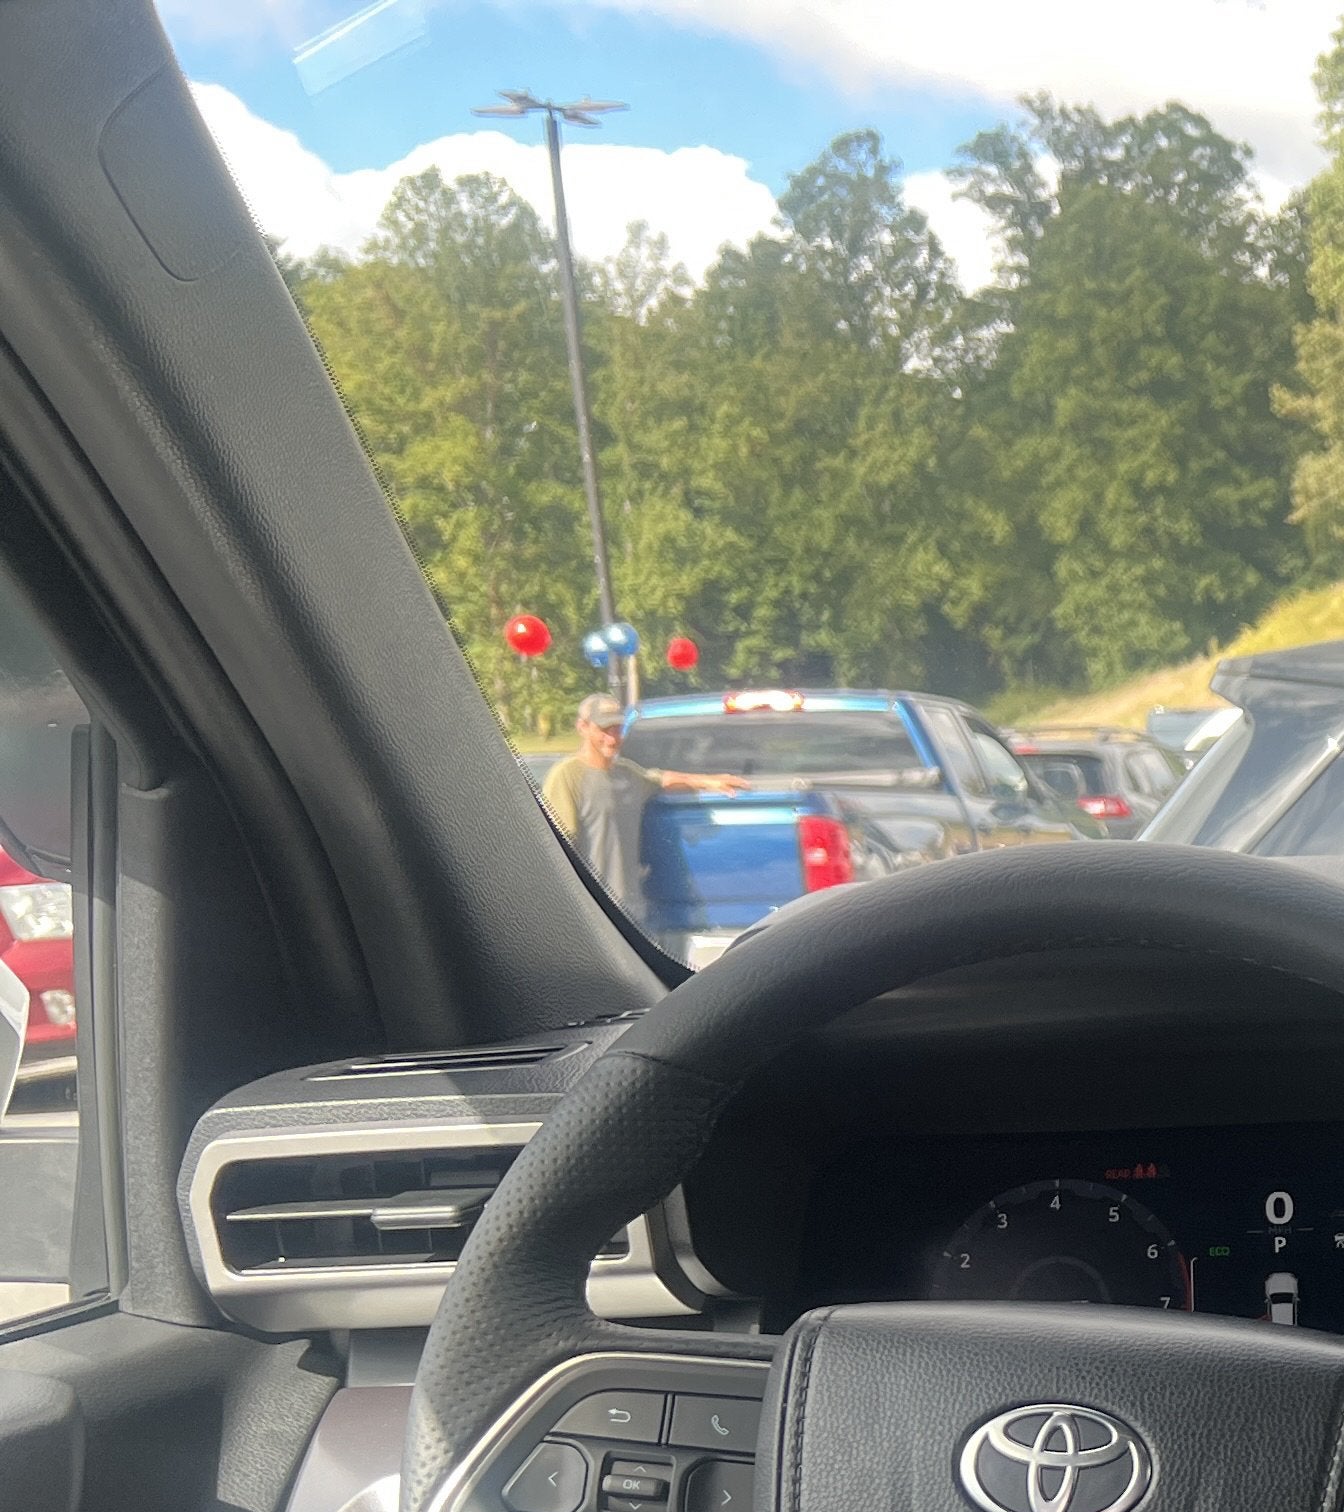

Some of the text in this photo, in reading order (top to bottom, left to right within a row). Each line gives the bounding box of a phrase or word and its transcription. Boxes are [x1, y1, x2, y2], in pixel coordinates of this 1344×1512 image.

[1050, 1194, 1061, 1211] 4
[1265, 1191, 1294, 1225] 0
[997, 1213, 1008, 1229] 3
[1108, 1206, 1119, 1223] 5
[1146, 1244, 1159, 1260] 6
[1274, 1236, 1286, 1253] P
[960, 1253, 971, 1269] 2
[1160, 1296, 1170, 1310] 7
[623, 1479, 640, 1490] OK
